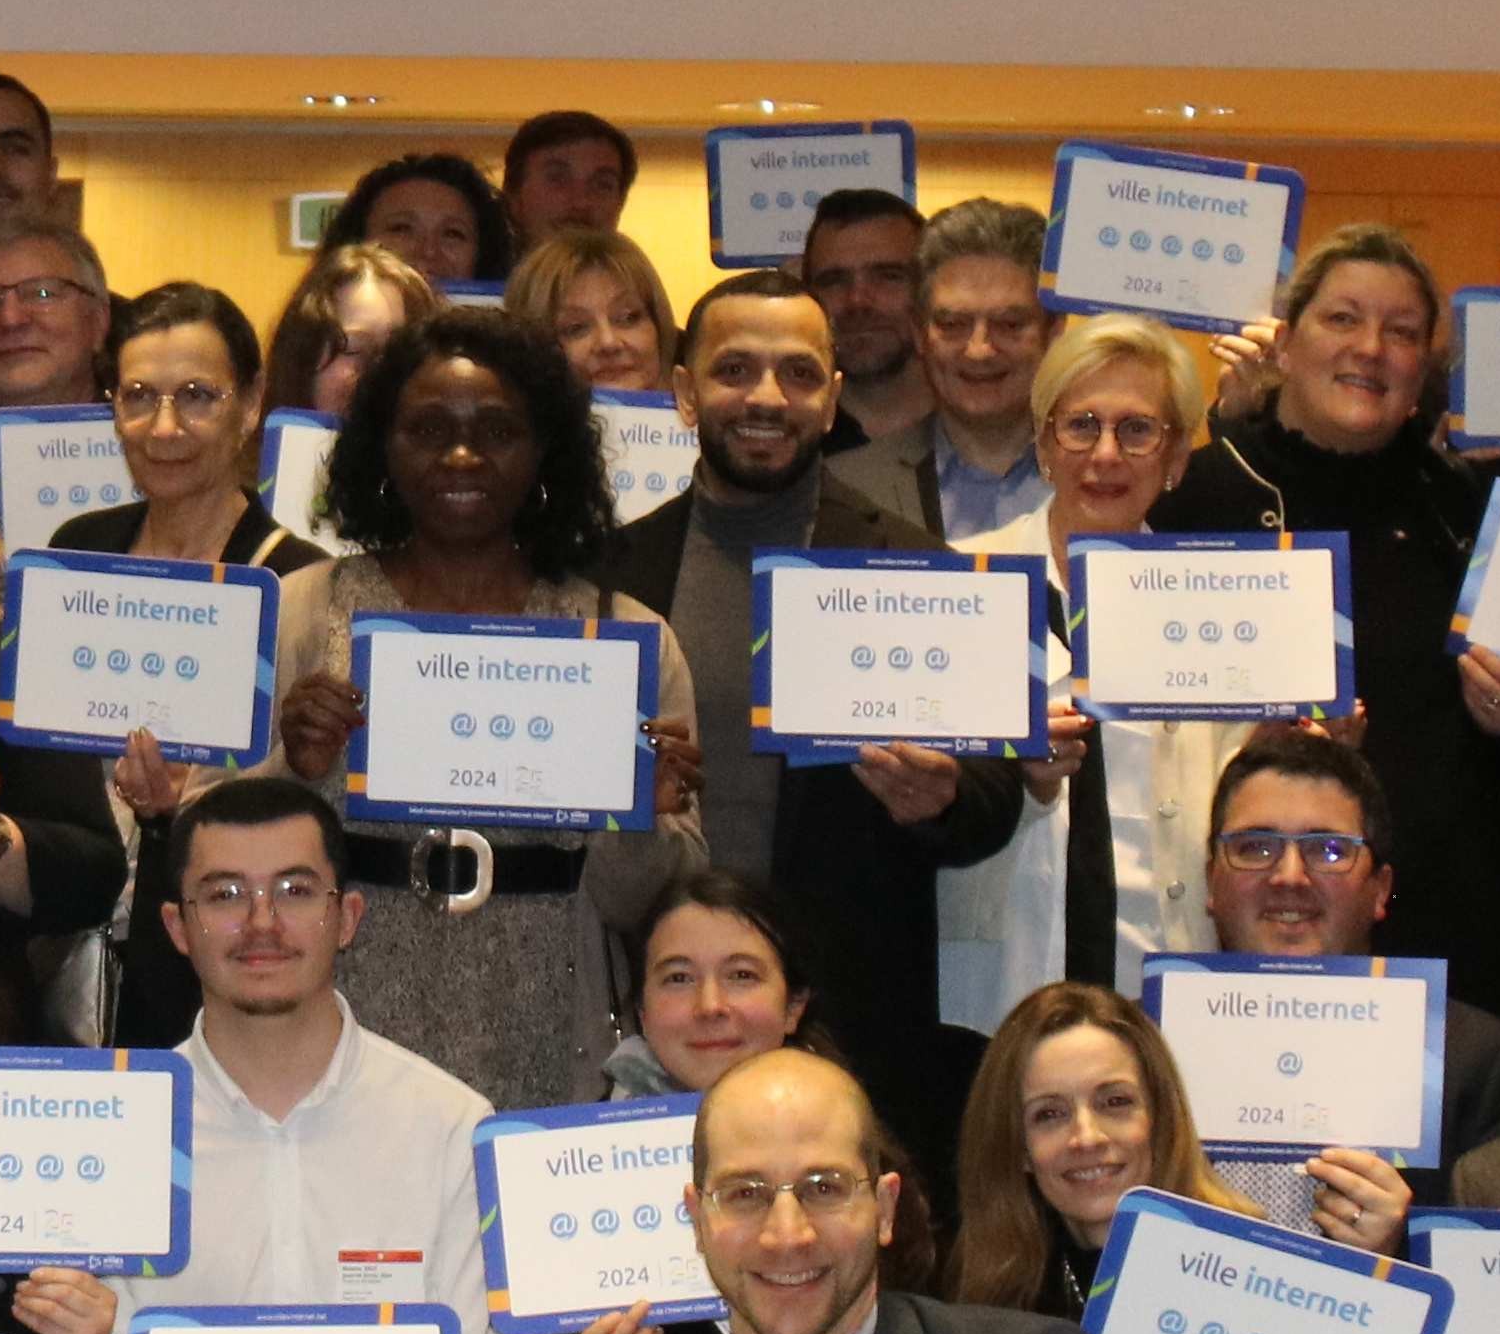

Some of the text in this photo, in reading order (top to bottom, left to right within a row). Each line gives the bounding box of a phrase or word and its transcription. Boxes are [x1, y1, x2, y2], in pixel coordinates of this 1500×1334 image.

[750, 150, 870, 170] ville internet
[1107, 180, 1248, 218] ville internet
[779, 230, 803, 244] 202
[1123, 275, 1163, 294] 2024
[619, 423, 664, 446] ville
[37, 437, 81, 459] ville
[1128, 567, 1289, 591] ville internet
[61, 589, 219, 627] ville internet
[815, 587, 985, 616] ville internet
[415, 652, 593, 685] ville internet
[1165, 671, 1209, 687] 2024
[86, 700, 129, 720] 2024
[851, 700, 897, 718] 2024
[449, 768, 497, 788] 2024
[1206, 991, 1378, 1021] ville internet
[2, 1091, 124, 1120] internet
[1237, 1106, 1284, 1124] 2024
[545, 1146, 604, 1178] ville
[597, 1266, 650, 1289] 2024
[1180, 1251, 1374, 1328] ville internet
